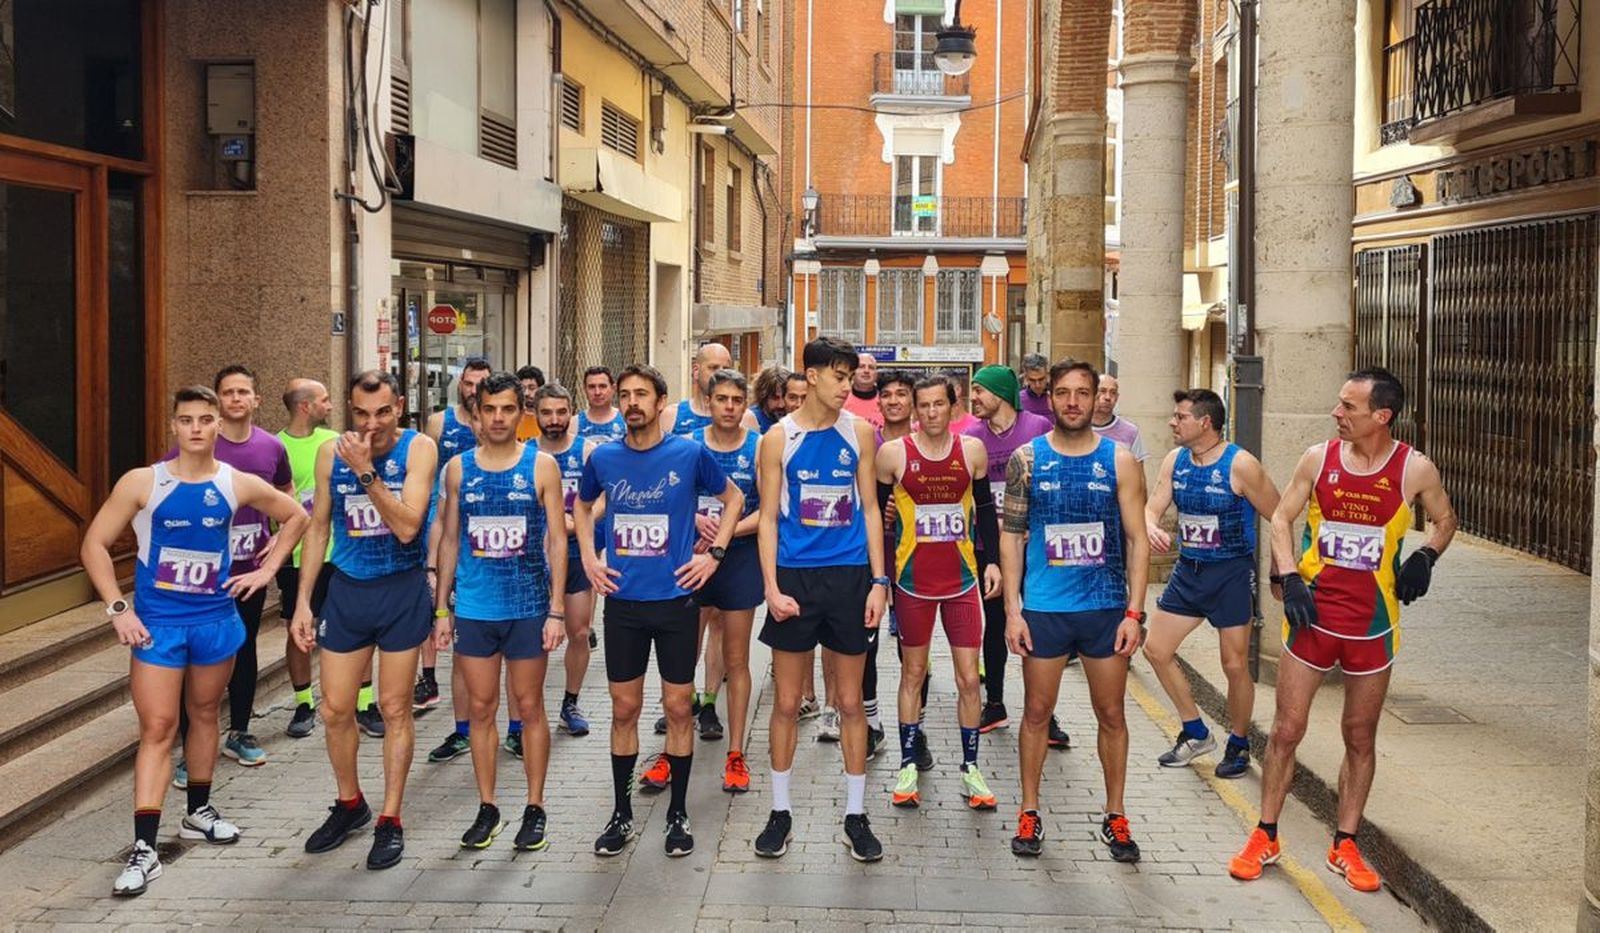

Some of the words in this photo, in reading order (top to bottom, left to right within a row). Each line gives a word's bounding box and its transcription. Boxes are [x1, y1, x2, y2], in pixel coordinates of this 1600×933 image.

[347, 504, 381, 530] 10
[820, 495, 839, 519] 7
[1332, 509, 1345, 518] DE
[1347, 511, 1377, 523] TORO
[1342, 502, 1369, 512] VINO
[918, 511, 964, 536] 116
[1180, 522, 1216, 543] 127
[471, 526, 525, 550] 108
[616, 524, 666, 549] 109
[1049, 532, 1103, 559] 110
[1321, 531, 1381, 563] 154
[171, 558, 209, 586] 10
